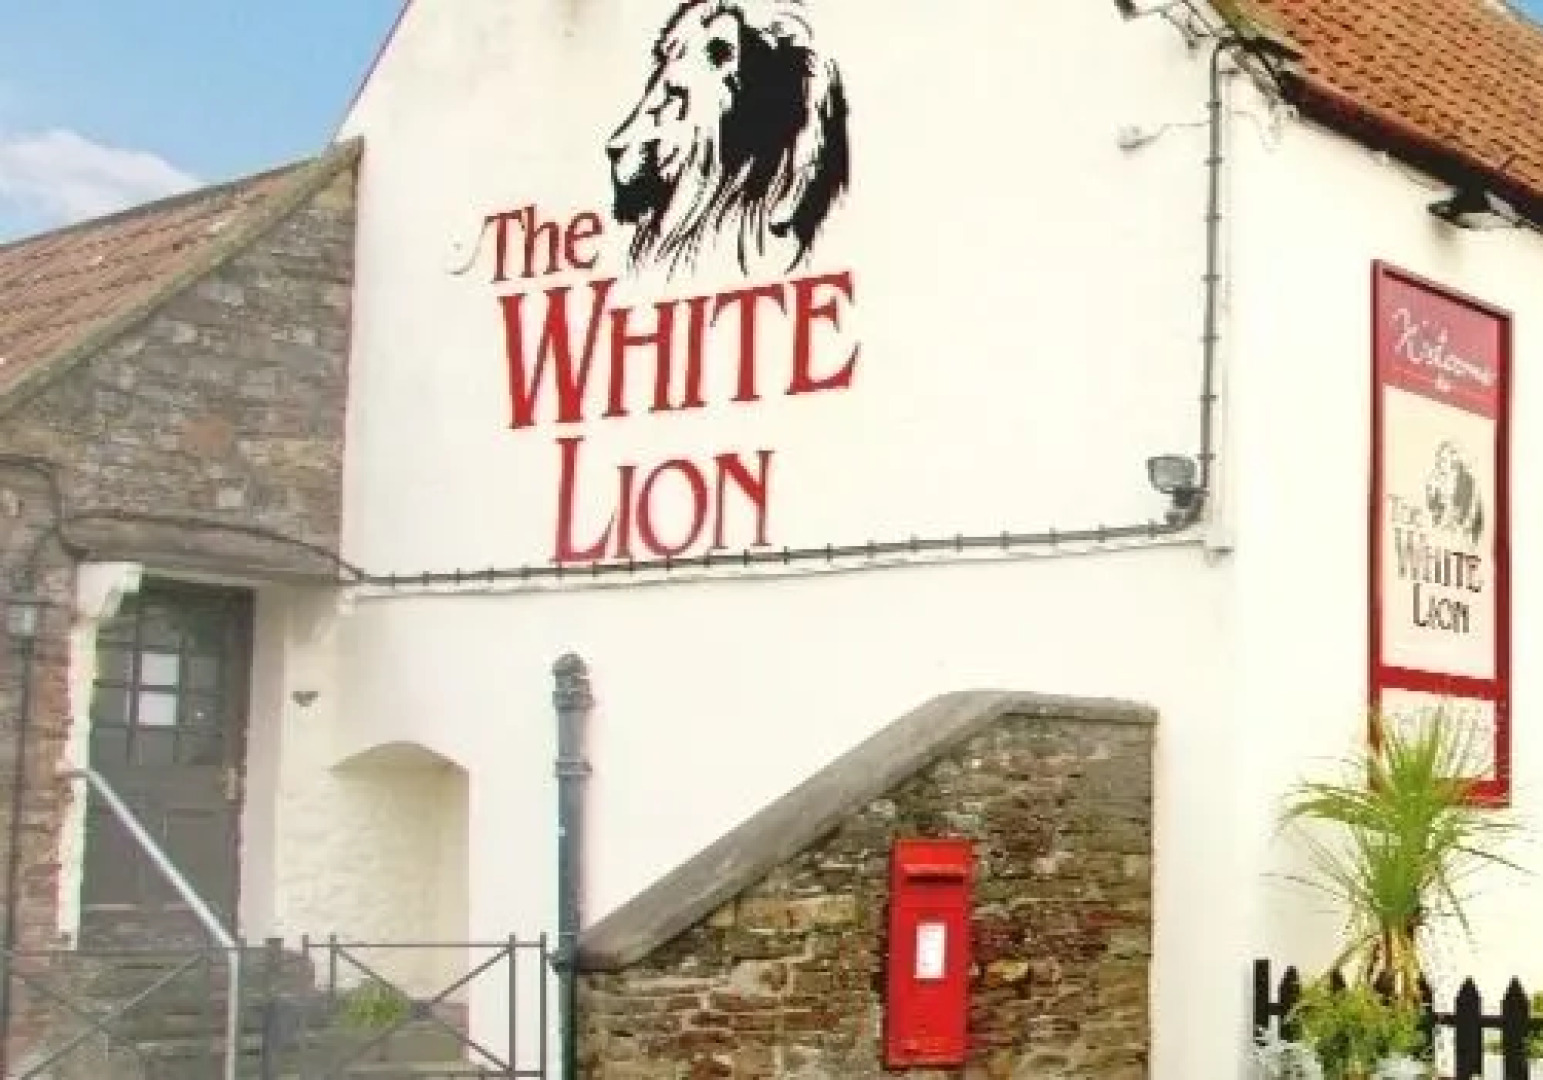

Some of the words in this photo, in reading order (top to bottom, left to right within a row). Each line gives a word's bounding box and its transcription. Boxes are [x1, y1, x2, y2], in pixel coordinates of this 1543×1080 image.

[460, 203, 603, 284] The
[496, 271, 861, 430] WHITE
[549, 435, 775, 565] LION
[1394, 526, 1485, 593] WHITE
